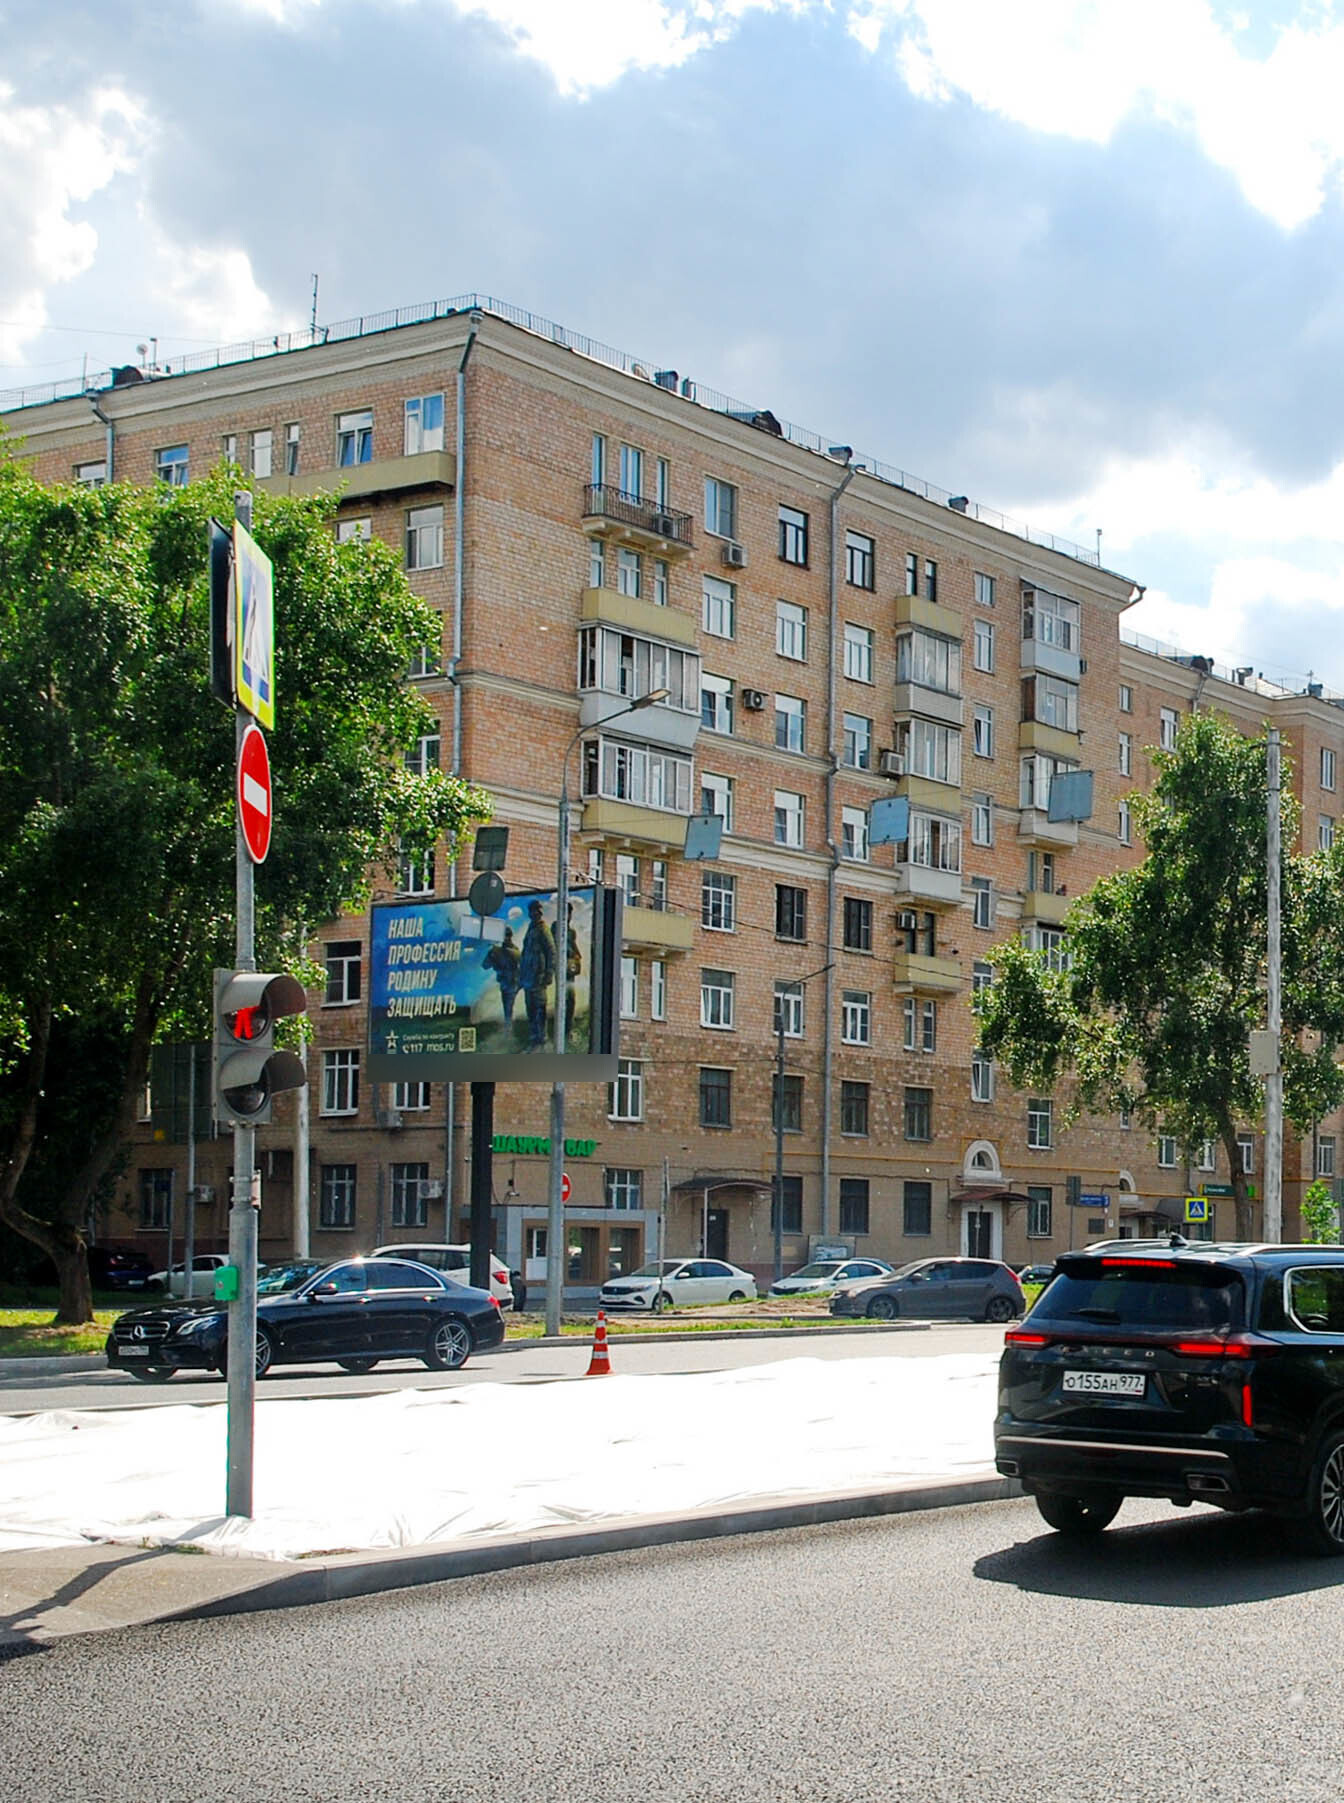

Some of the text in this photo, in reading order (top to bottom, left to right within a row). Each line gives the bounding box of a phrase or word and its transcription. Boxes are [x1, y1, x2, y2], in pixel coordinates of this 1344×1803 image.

[388, 918, 423, 938] НАША
[388, 941, 460, 965] ПРОФЕССИЯ
[388, 969, 437, 991] РОДИНУ
[387, 995, 457, 1019] ЗАЩИЩАТЬ
[492, 1135, 553, 1155] ШАУРМ
